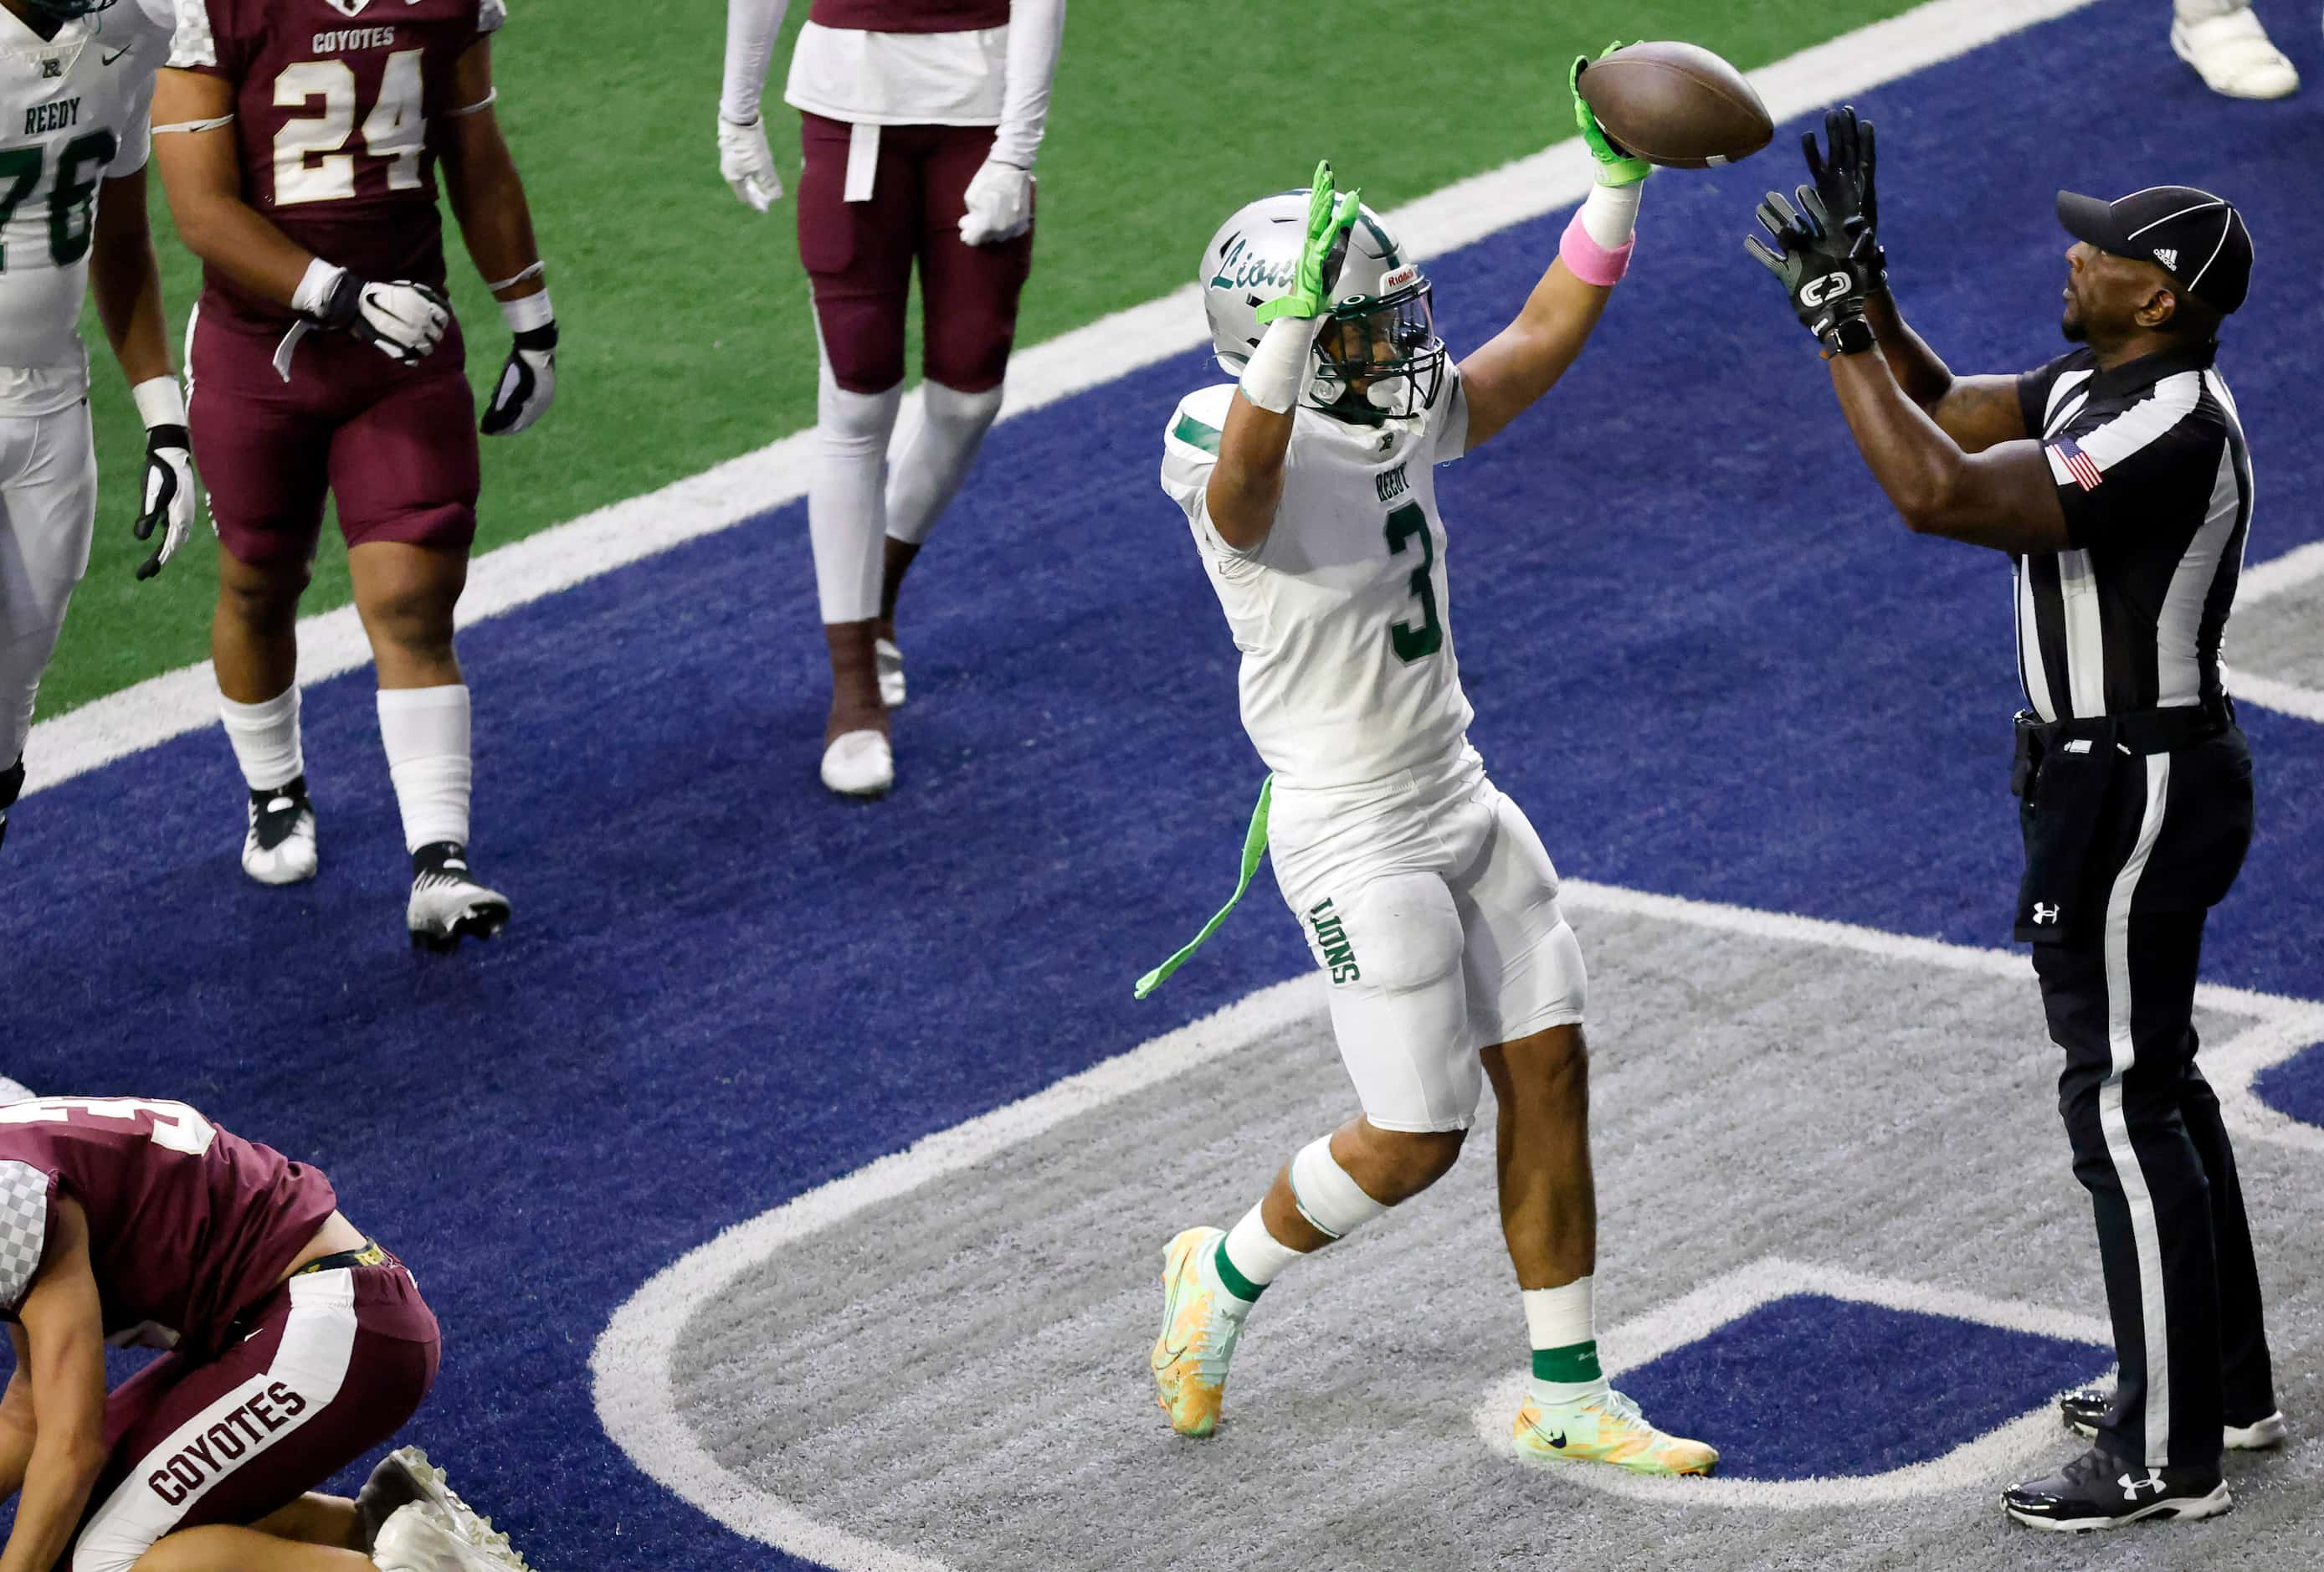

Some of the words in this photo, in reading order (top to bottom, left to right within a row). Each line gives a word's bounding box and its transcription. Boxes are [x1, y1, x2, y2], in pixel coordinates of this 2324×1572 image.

[312, 26, 395, 54] COYOTES
[24, 96, 80, 135] REEDY
[273, 47, 428, 206] 24
[0, 127, 116, 270] 76
[1210, 239, 1296, 290] Lion
[2153, 249, 2178, 271] adidas
[1376, 461, 1409, 502] REEDY
[1385, 498, 1443, 667] 3
[1311, 897, 1360, 984] LIONS
[149, 1381, 306, 1507] COYOTES
